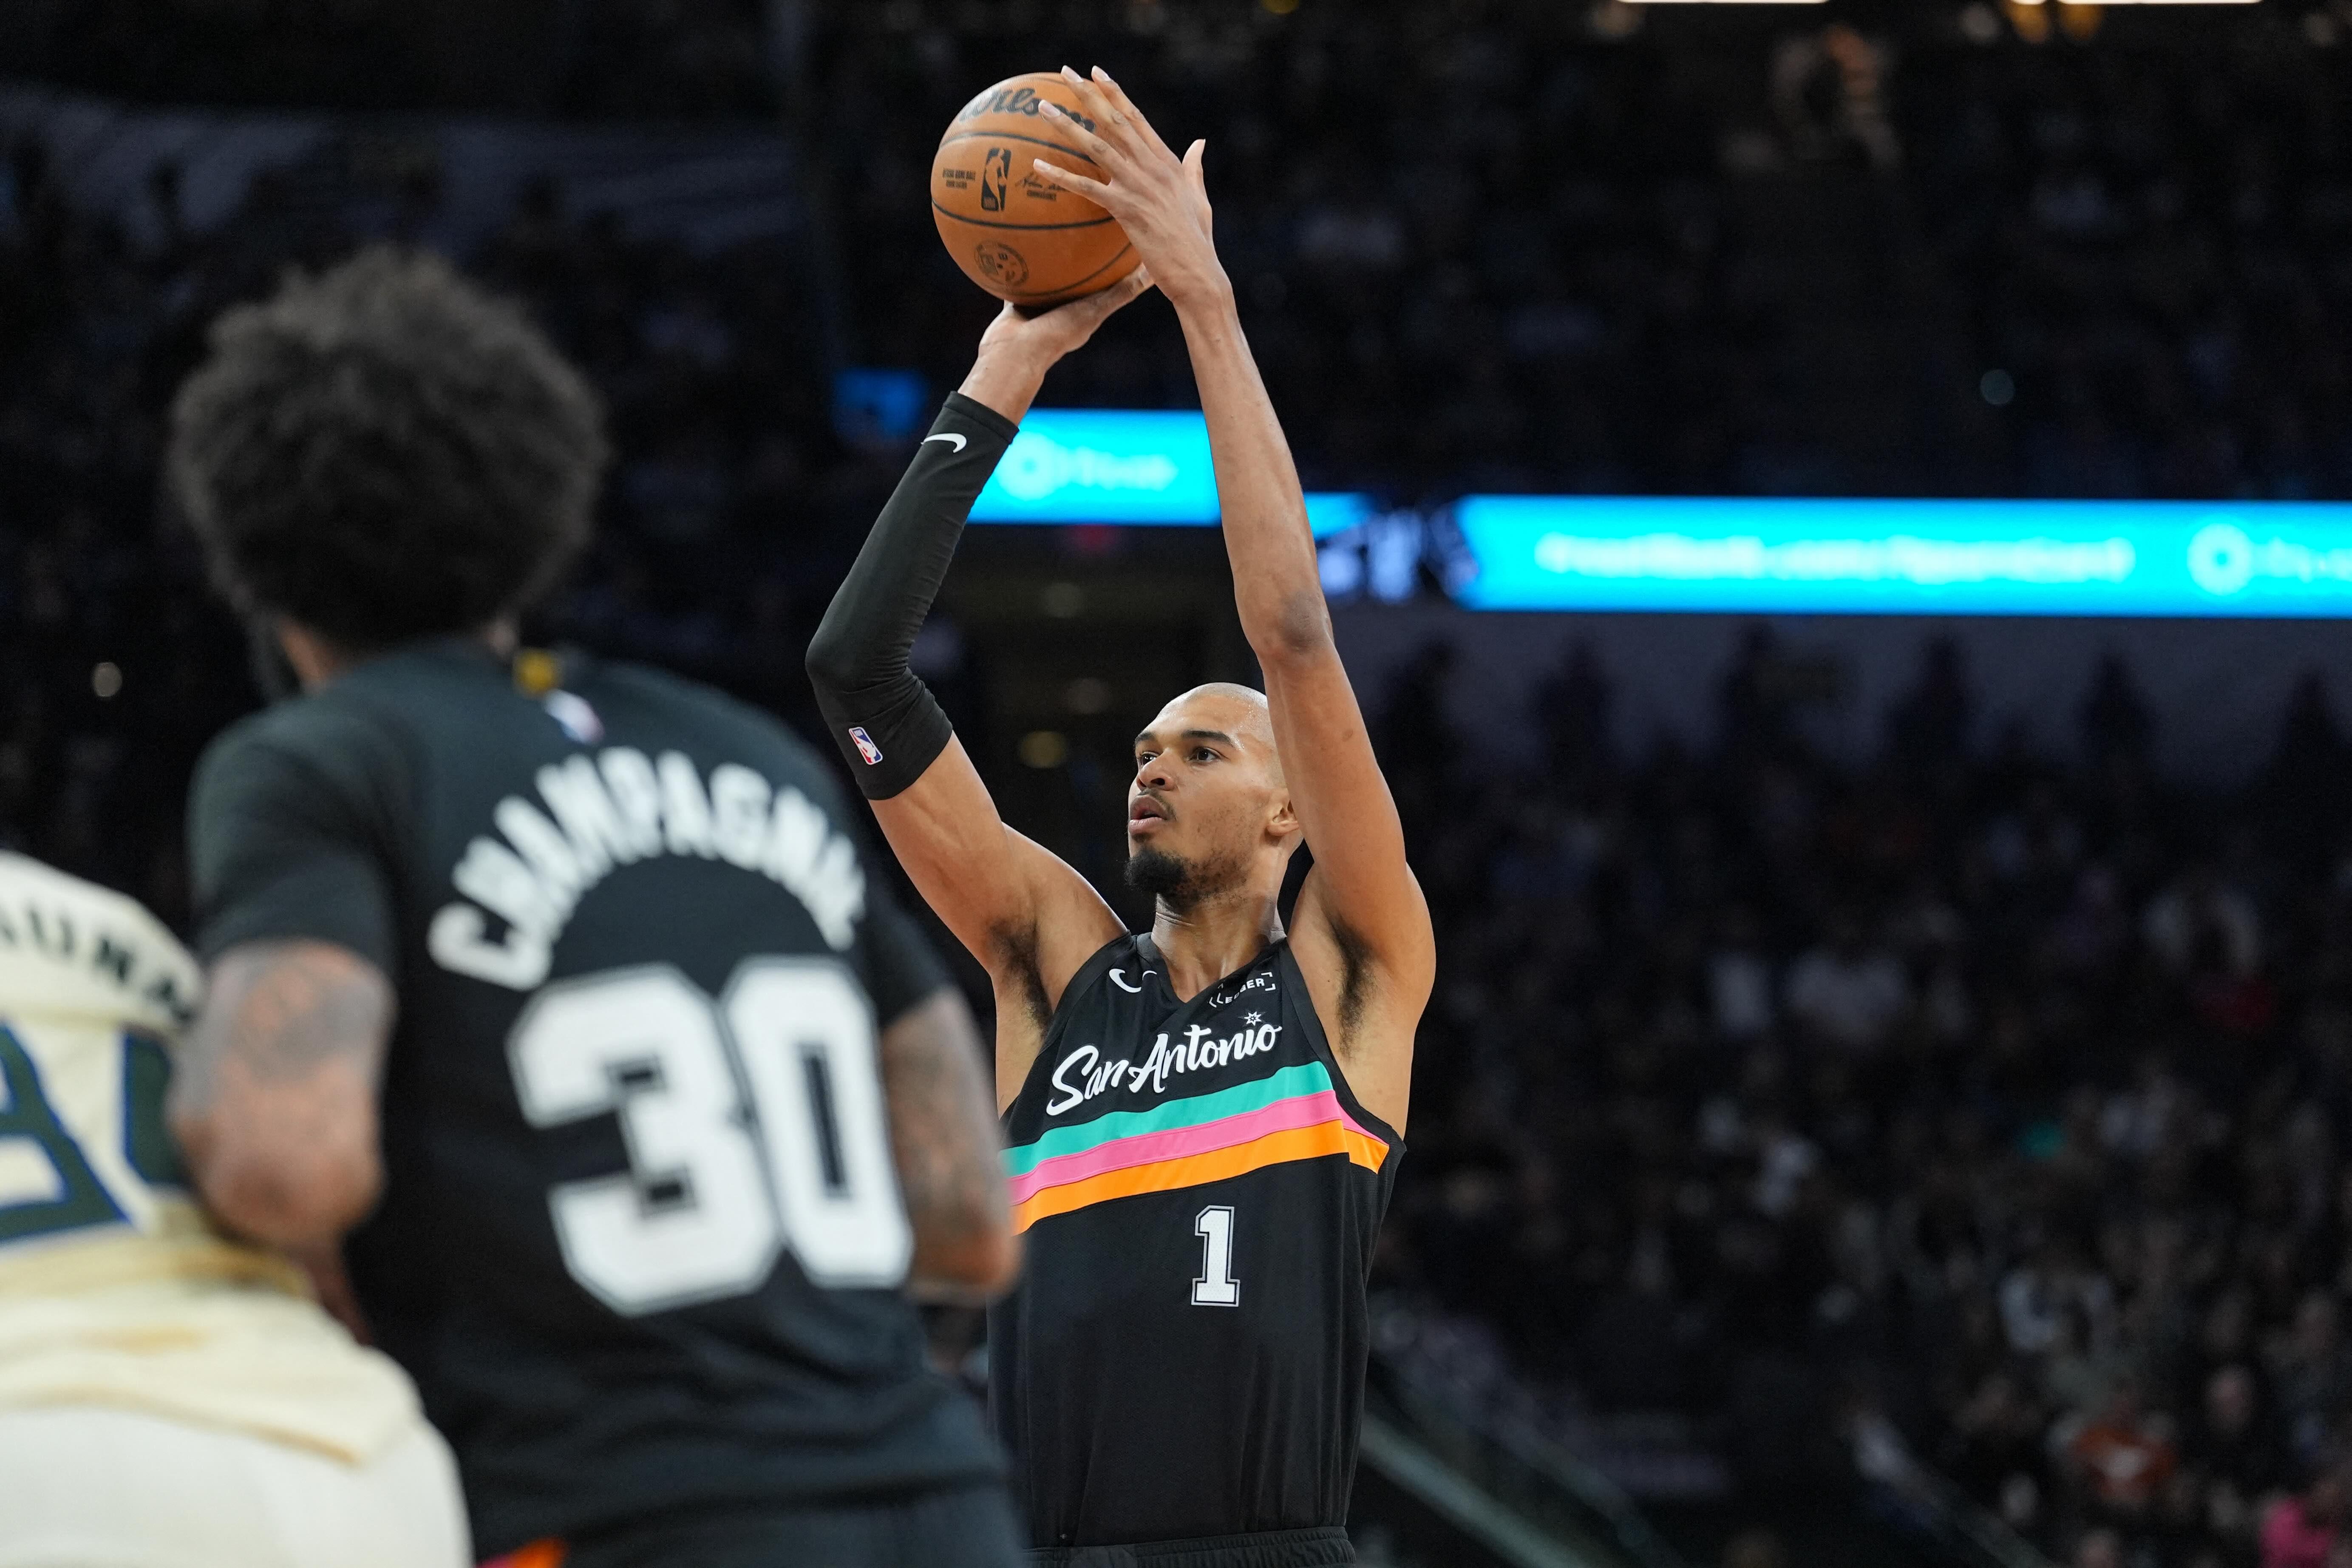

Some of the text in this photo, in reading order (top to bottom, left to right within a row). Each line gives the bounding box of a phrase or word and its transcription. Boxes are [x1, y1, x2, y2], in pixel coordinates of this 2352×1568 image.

[1046, 1024, 1282, 1116] San Antonio
[505, 954, 914, 1318] 30
[1191, 1205, 1241, 1307] 1
